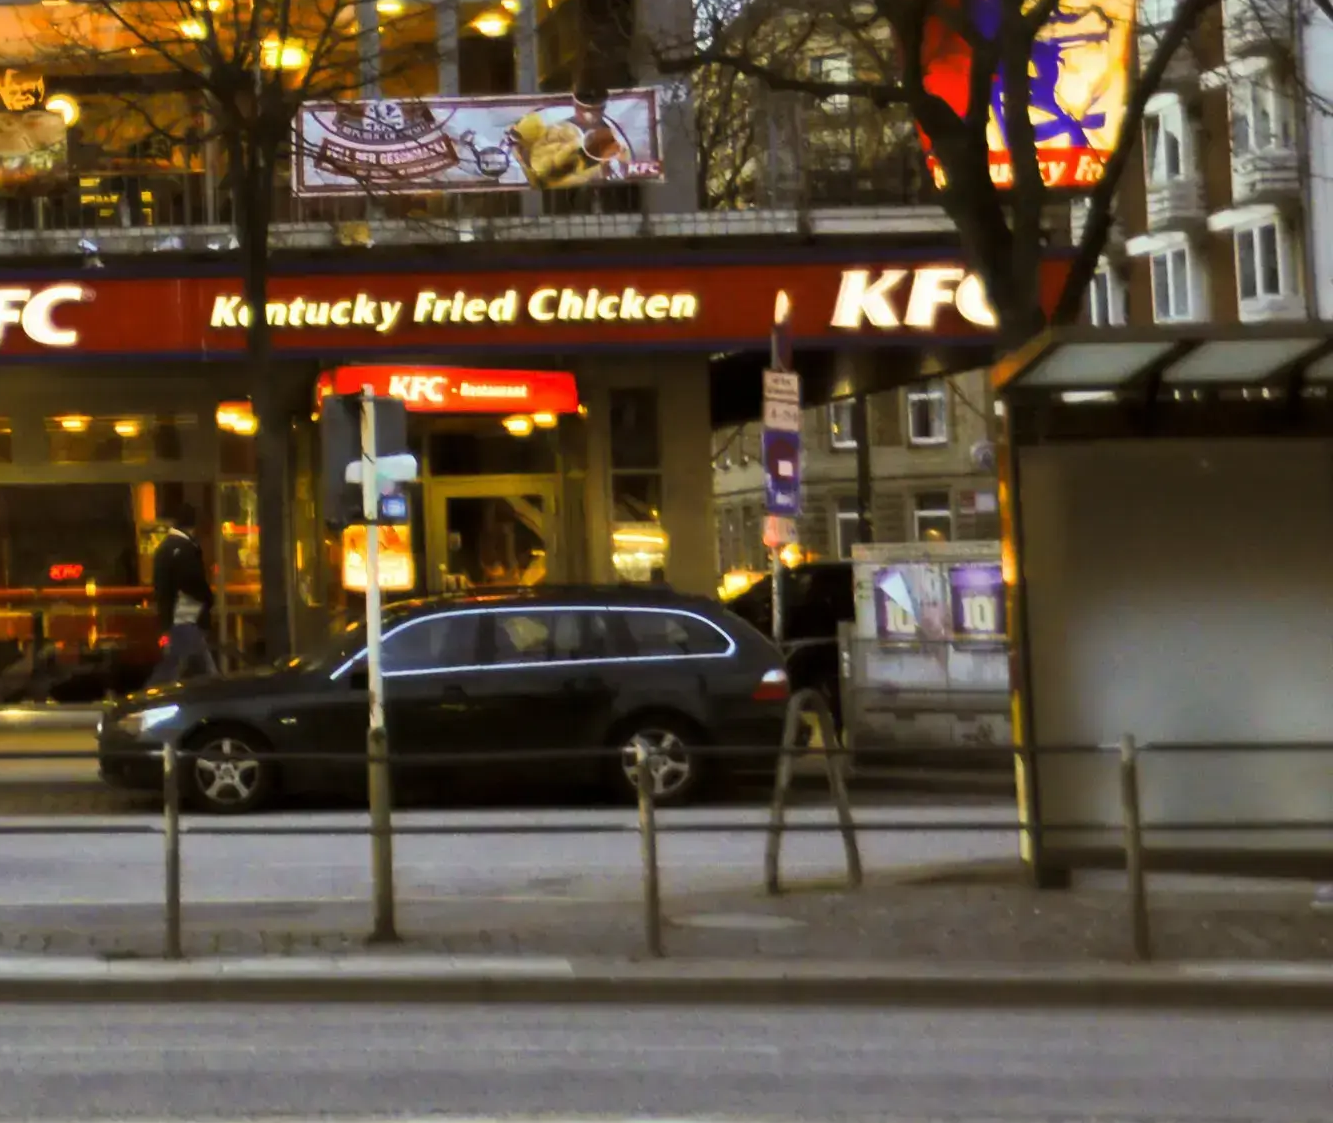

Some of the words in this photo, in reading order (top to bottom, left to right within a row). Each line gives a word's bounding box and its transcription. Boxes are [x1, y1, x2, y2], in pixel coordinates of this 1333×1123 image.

[627, 162, 660, 174] KFC
[412, 290, 517, 323] Fried
[527, 287, 698, 322] Chicken
[388, 375, 447, 402] KFC
